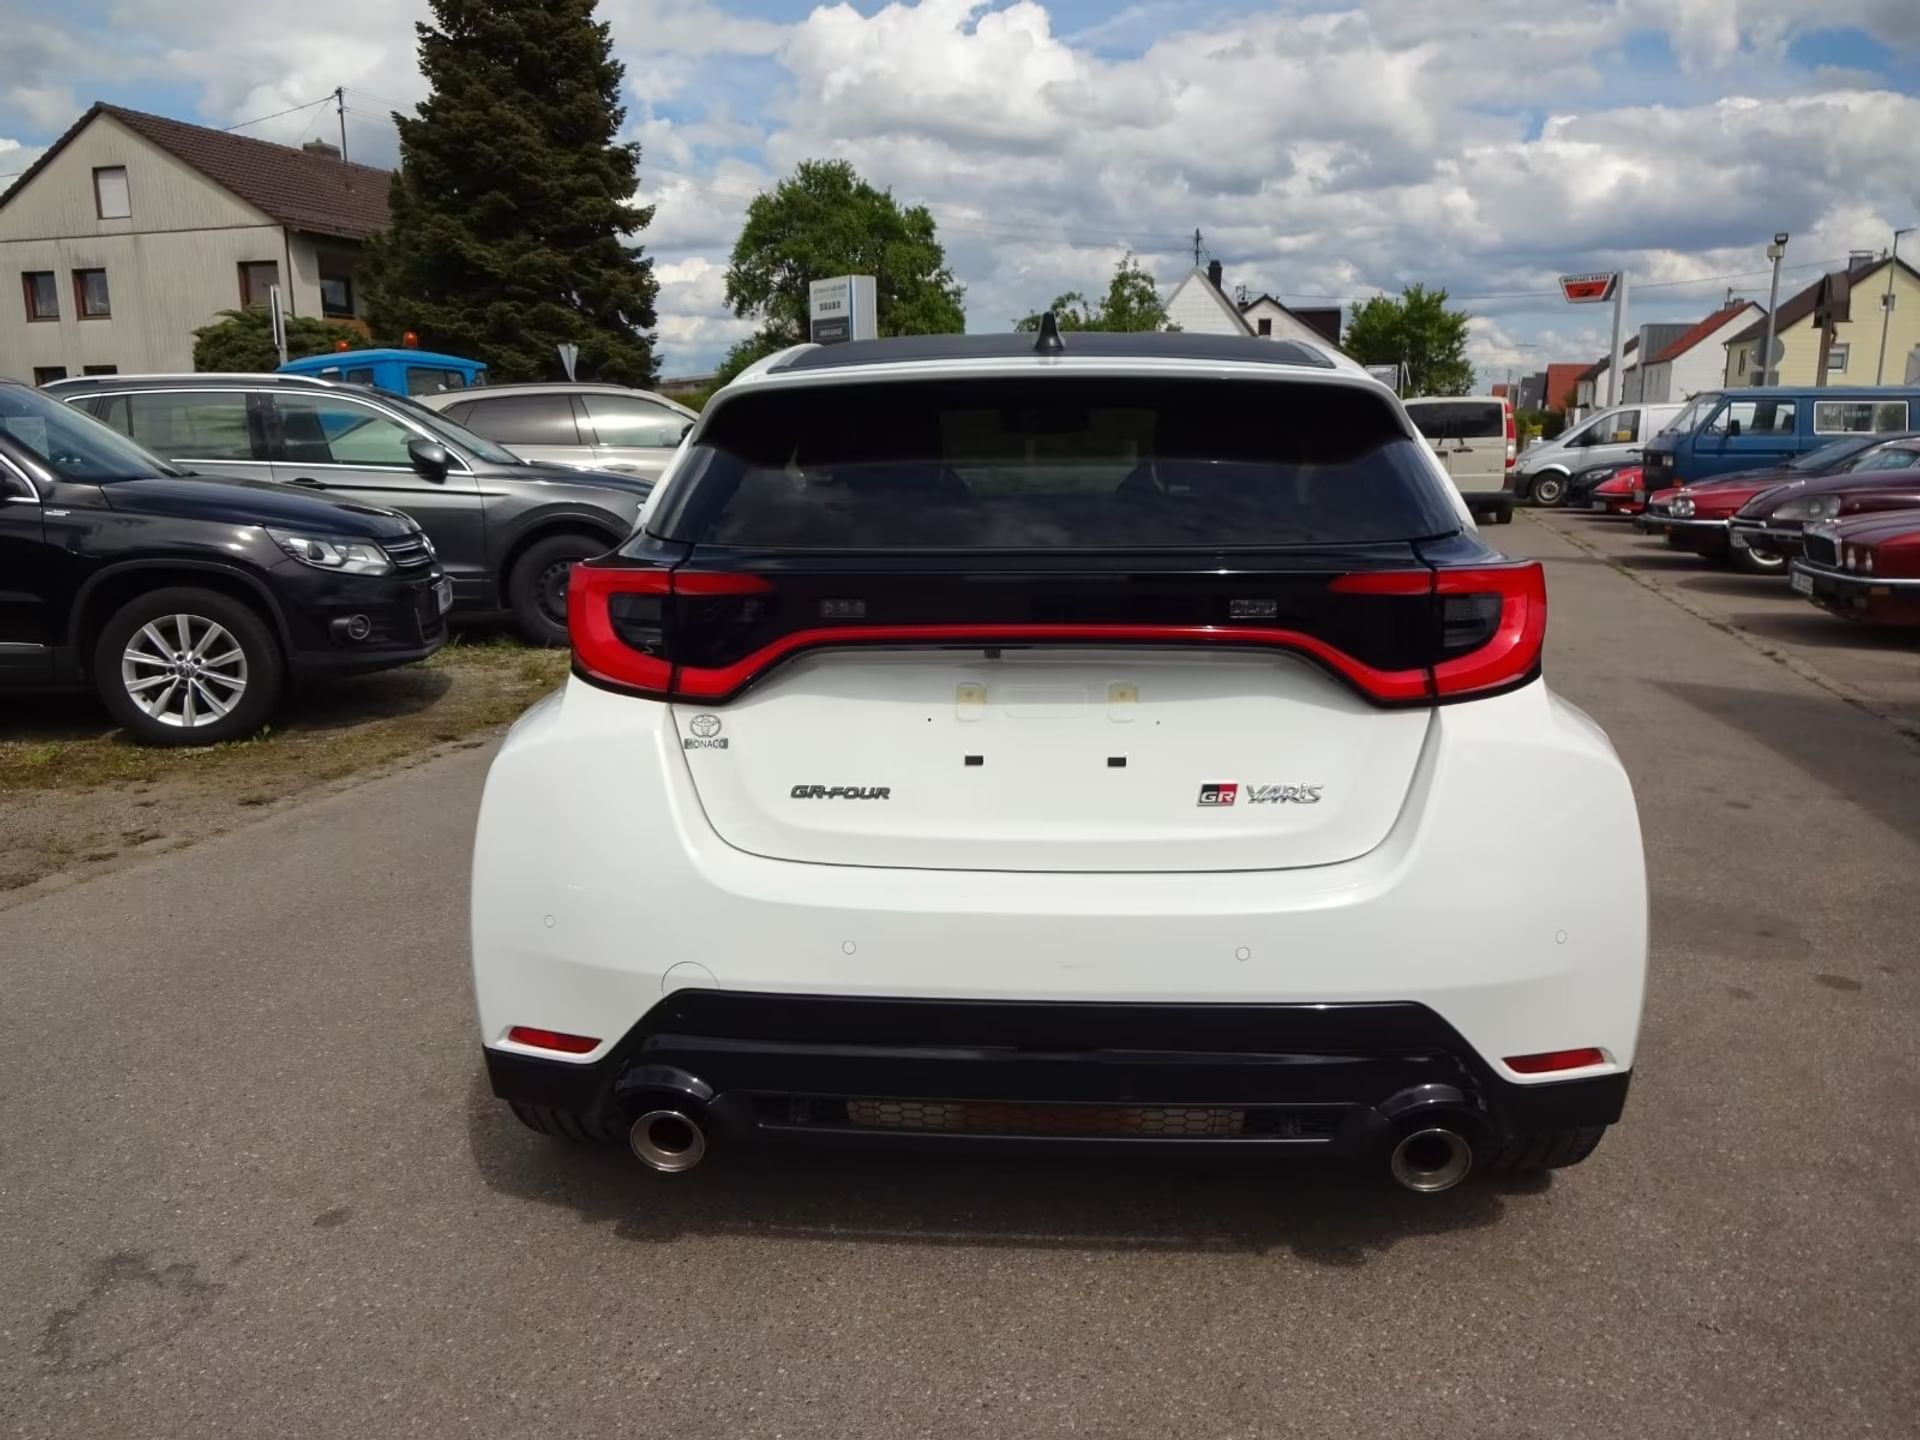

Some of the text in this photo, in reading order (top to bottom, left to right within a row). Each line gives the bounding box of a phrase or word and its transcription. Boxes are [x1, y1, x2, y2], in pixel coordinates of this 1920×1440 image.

[685, 738, 728, 749] MONACO
[790, 784, 891, 799] GR-FOUR
[1199, 788, 1237, 804] GR
